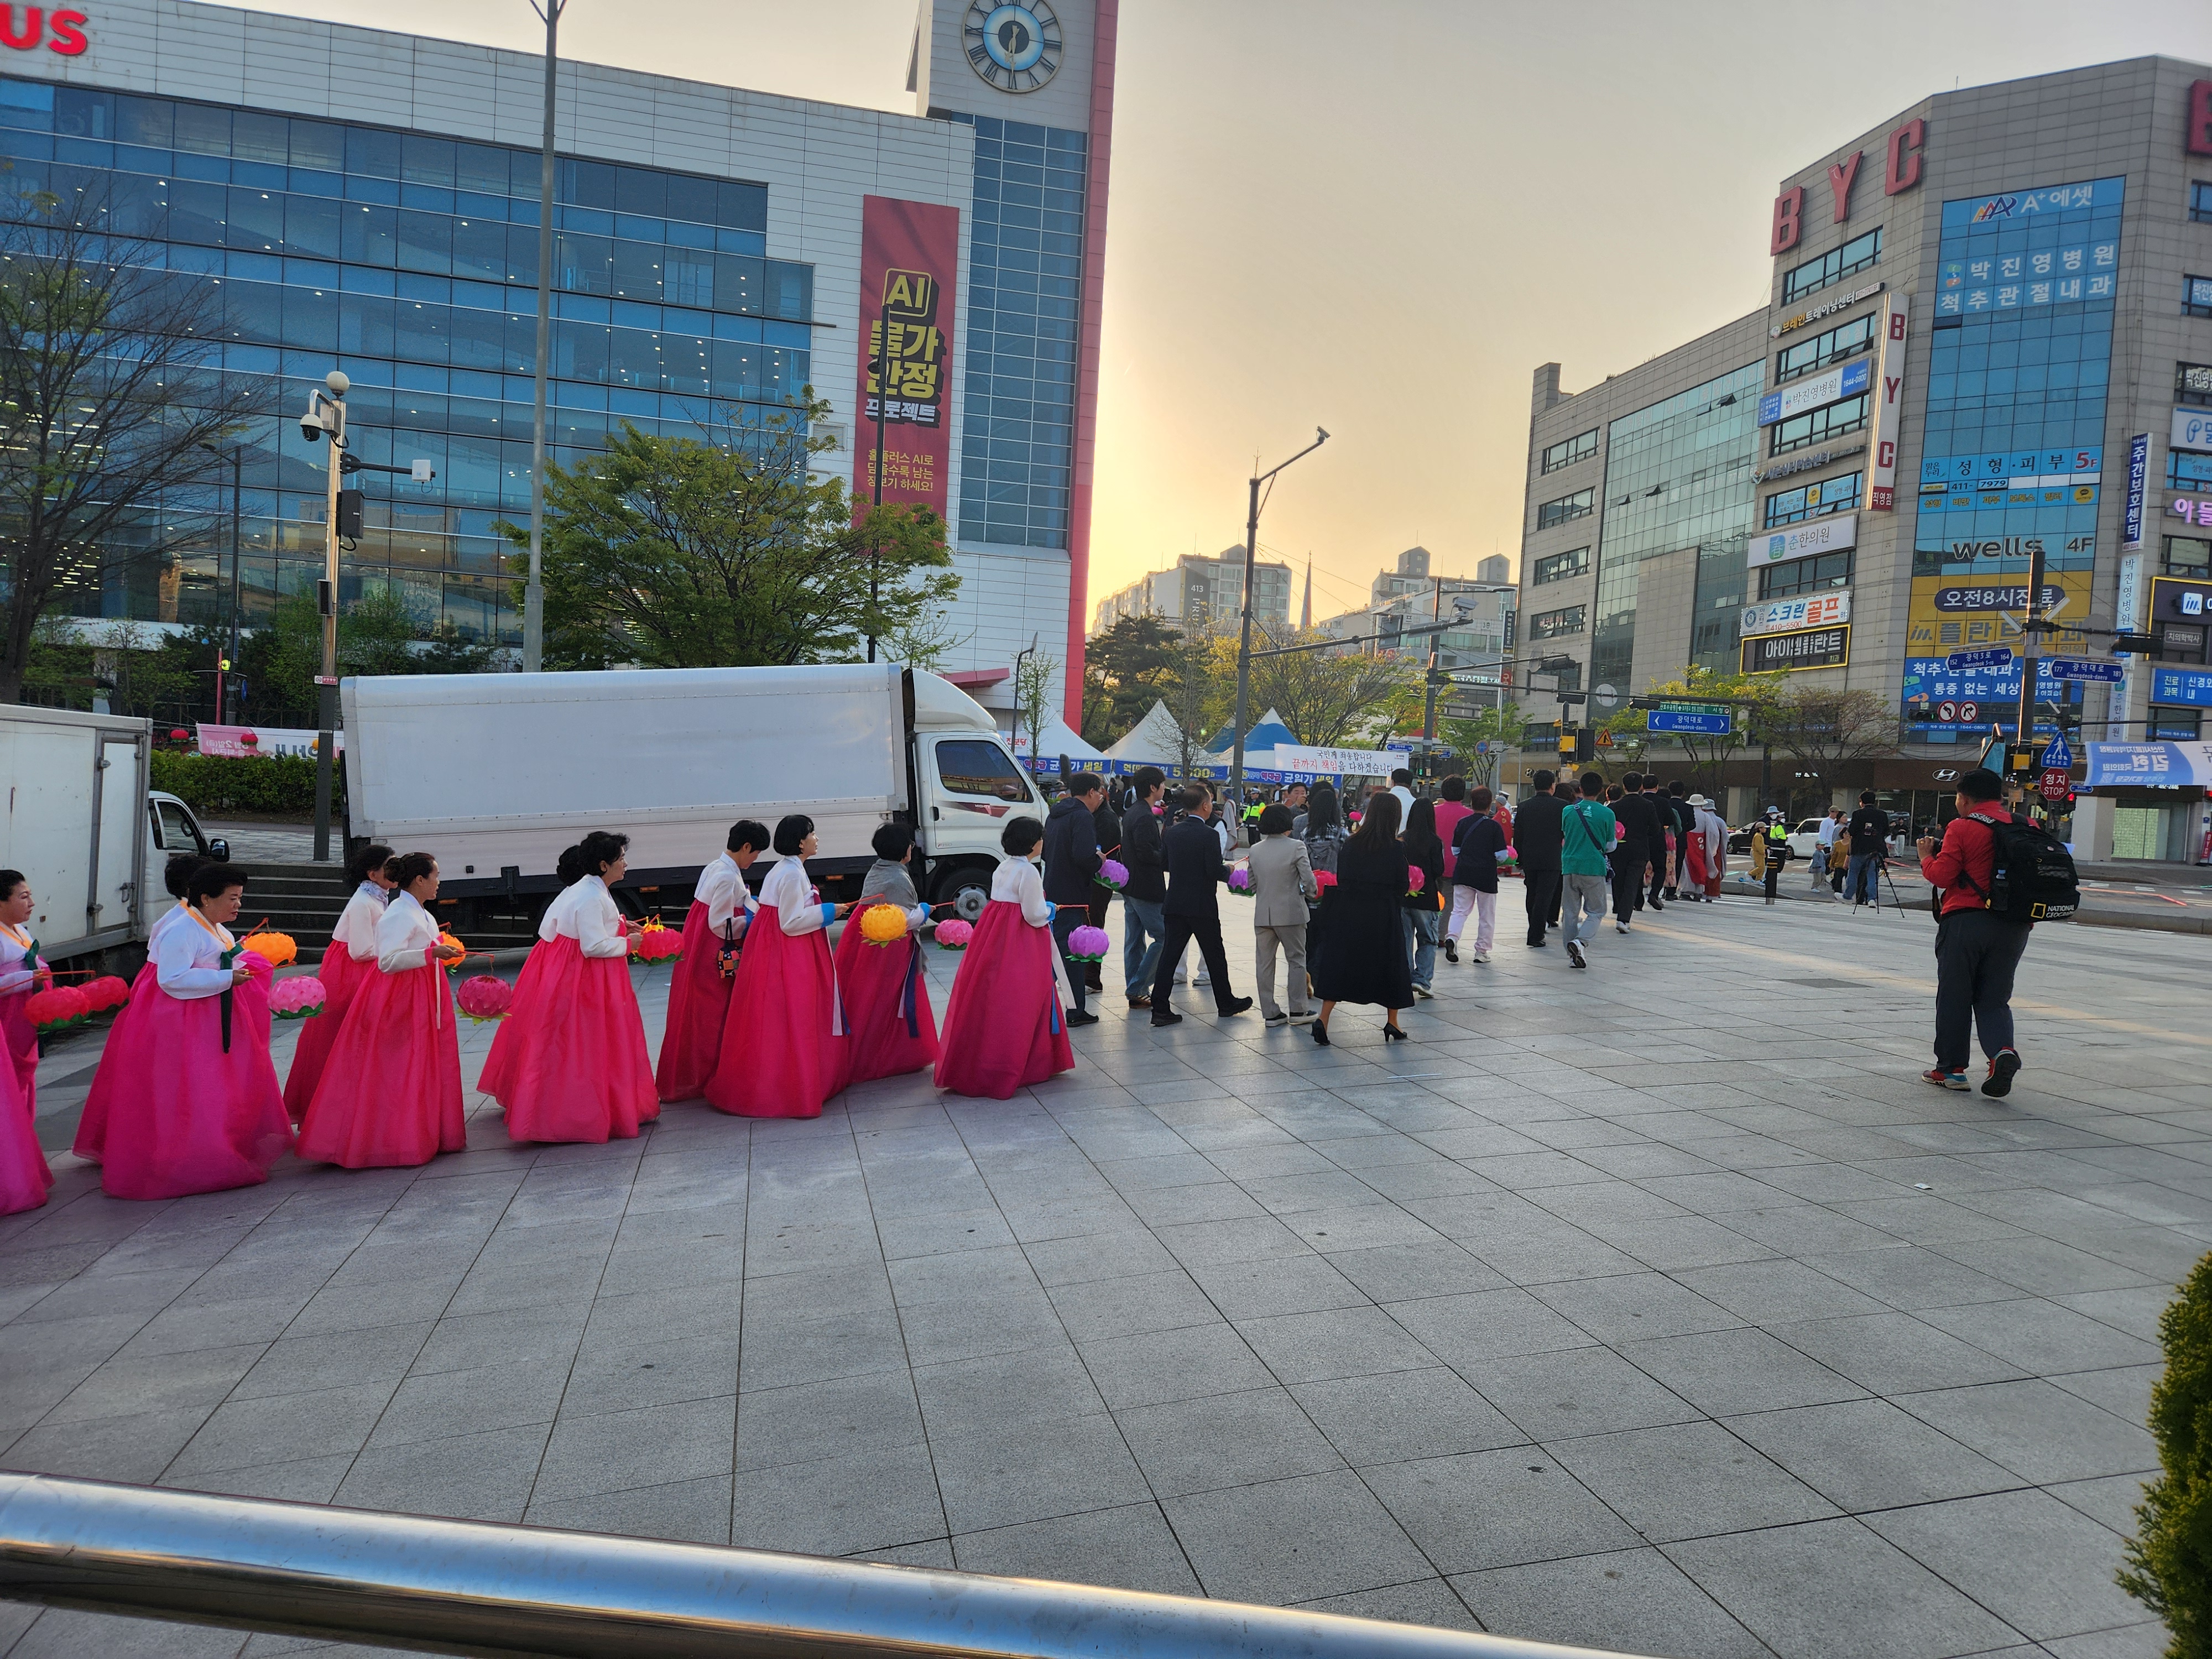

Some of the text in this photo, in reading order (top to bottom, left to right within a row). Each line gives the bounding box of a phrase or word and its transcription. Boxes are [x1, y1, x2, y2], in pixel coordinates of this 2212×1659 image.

[0, 3, 88, 55] US
[1770, 118, 1924, 257] BYC
[1970, 244, 2114, 281] 박진영병원
[886, 274, 926, 309] AI
[1940, 275, 2112, 312] 척추관절내과
[2193, 281, 2212, 301] 박진
[1782, 290, 1855, 333] 브레인트레이닝센터
[868, 320, 939, 362] 물가
[866, 358, 938, 399] 안정
[2186, 368, 2212, 389] 박진영
[1793, 378, 1837, 405] 박진영병원
[1878, 312, 1906, 468] BYC
[864, 398, 937, 422] 프로젝트
[912, 454, 934, 466] AI로
[2075, 451, 2098, 469] 5F
[912, 467, 933, 480] 남는
[1924, 468, 1939, 477] 누리
[900, 478, 933, 492] 하세요!
[1981, 479, 2006, 488] 7979
[1873, 491, 1892, 506] 직영점
[2127, 445, 2146, 539] 주간보호센터
[1924, 492, 2063, 508] 성형 비만 피부 보톡스 필러
[1788, 526, 1830, 550] 춘한의원
[1952, 536, 2094, 560] wells 4F
[1191, 585, 1204, 593] 413
[2120, 558, 2136, 625] 박진영병원
[1766, 602, 1806, 623] 스크린
[1807, 597, 1839, 624] 골프
[1771, 620, 1802, 632] 410-5500
[1766, 631, 1841, 658] 아이엠플란트
[2168, 632, 2200, 644] 치의학박사
[1829, 654, 1840, 662] 치과
[1965, 651, 1992, 662] 광덕3로
[2072, 663, 2105, 673] 광덕대로
[2066, 672, 2108, 680] Gwangdeok-daero
[2164, 675, 2179, 686] 진료
[1934, 682, 2020, 696] 통증 없는 세상
[2035, 681, 2063, 690] 영병원
[2163, 686, 2179, 697] 과목
[1677, 715, 1703, 724] 광덕대로
[2111, 692, 2122, 737] 춘한의원
[1006, 737, 1027, 746] 진보당
[1317, 750, 1373, 761] 국민께 죄송합니다
[1024, 759, 1103, 772] 역급 균가 세일
[1172, 766, 1215, 778] 5,00원
[1292, 758, 1394, 774] 끝까지 책임을 다하겠습니다
[1284, 773, 1313, 785] 균일가
[2045, 774, 2065, 785] 정지
[2044, 786, 2064, 795] STOP
[1969, 812, 1995, 824] PRESS
